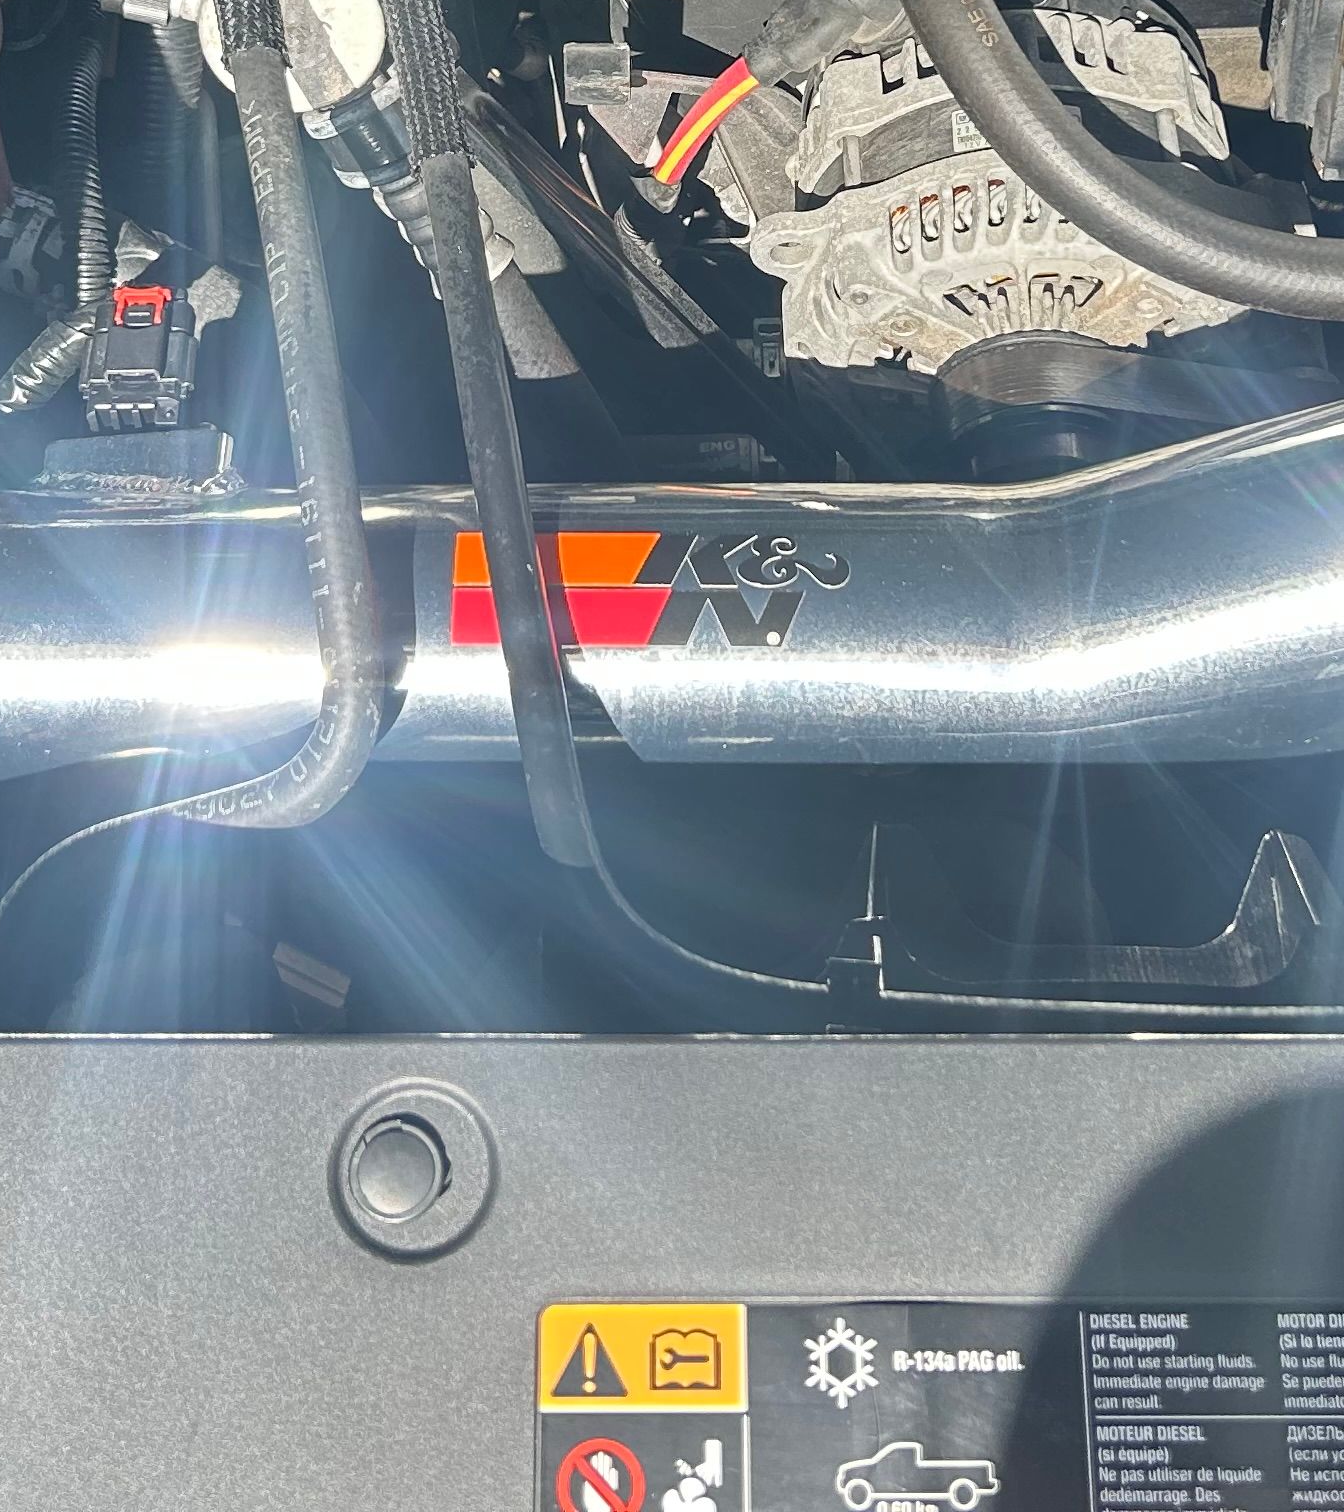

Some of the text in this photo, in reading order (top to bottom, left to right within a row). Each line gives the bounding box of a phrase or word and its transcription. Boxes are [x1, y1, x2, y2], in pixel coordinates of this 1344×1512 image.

[967, 7, 1000, 48] SAE
[1089, 1313, 1190, 1329] DIESEL ENGINE
[1277, 1313, 1324, 1328] MOTOR
[1091, 1334, 1176, 1351] (If Equipped)
[1279, 1333, 1297, 1350] (Si
[1300, 1334, 1313, 1348] lo
[893, 1350, 1025, 1372] R-134a PAG oil.
[1092, 1354, 1256, 1371] Do not use starting fluids.
[1280, 1354, 1298, 1368] No
[1302, 1355, 1325, 1368] use
[1093, 1374, 1265, 1391] Immediate engine damage
[1282, 1374, 1299, 1388] Se
[1094, 1395, 1162, 1409] can result.
[1096, 1426, 1206, 1441] MOTEUR DIESEL
[1098, 1446, 1169, 1464] (si équipé)
[1288, 1449, 1329, 1463] (если
[1099, 1467, 1262, 1484] Ne pas utiliser de liquide
[1290, 1468, 1310, 1482] Не
[1195, 1487, 1221, 1502] Des
